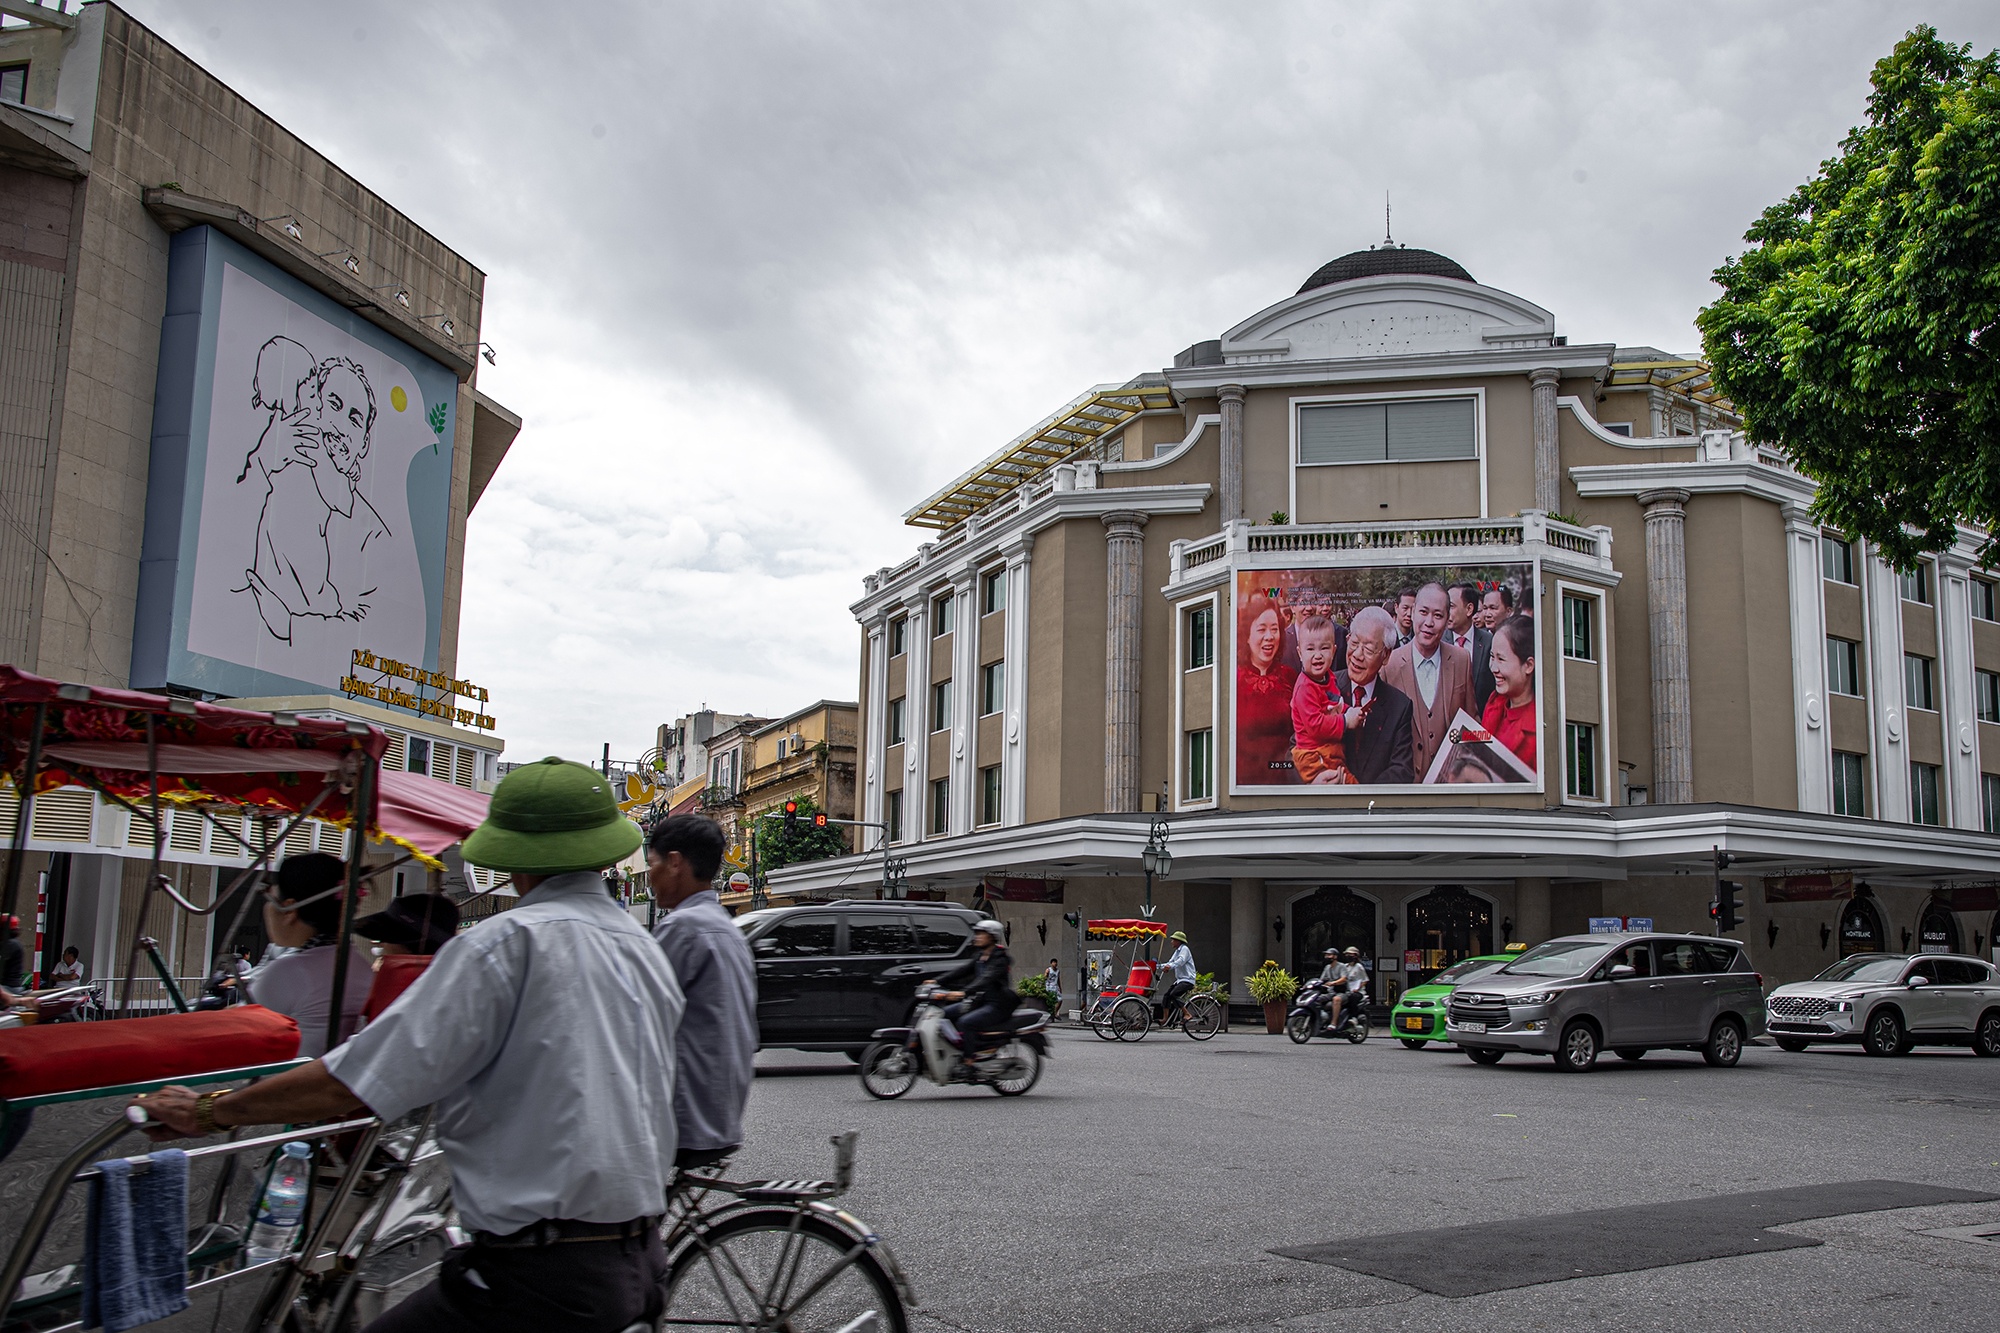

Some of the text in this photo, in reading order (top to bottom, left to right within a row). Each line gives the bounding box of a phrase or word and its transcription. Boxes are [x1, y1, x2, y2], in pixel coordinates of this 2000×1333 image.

[479, 687, 489, 703] TA
[445, 704, 456, 720] TO
[1845, 930, 1871, 938] MONTBLANC
[1923, 932, 1946, 940] HUBLOT
